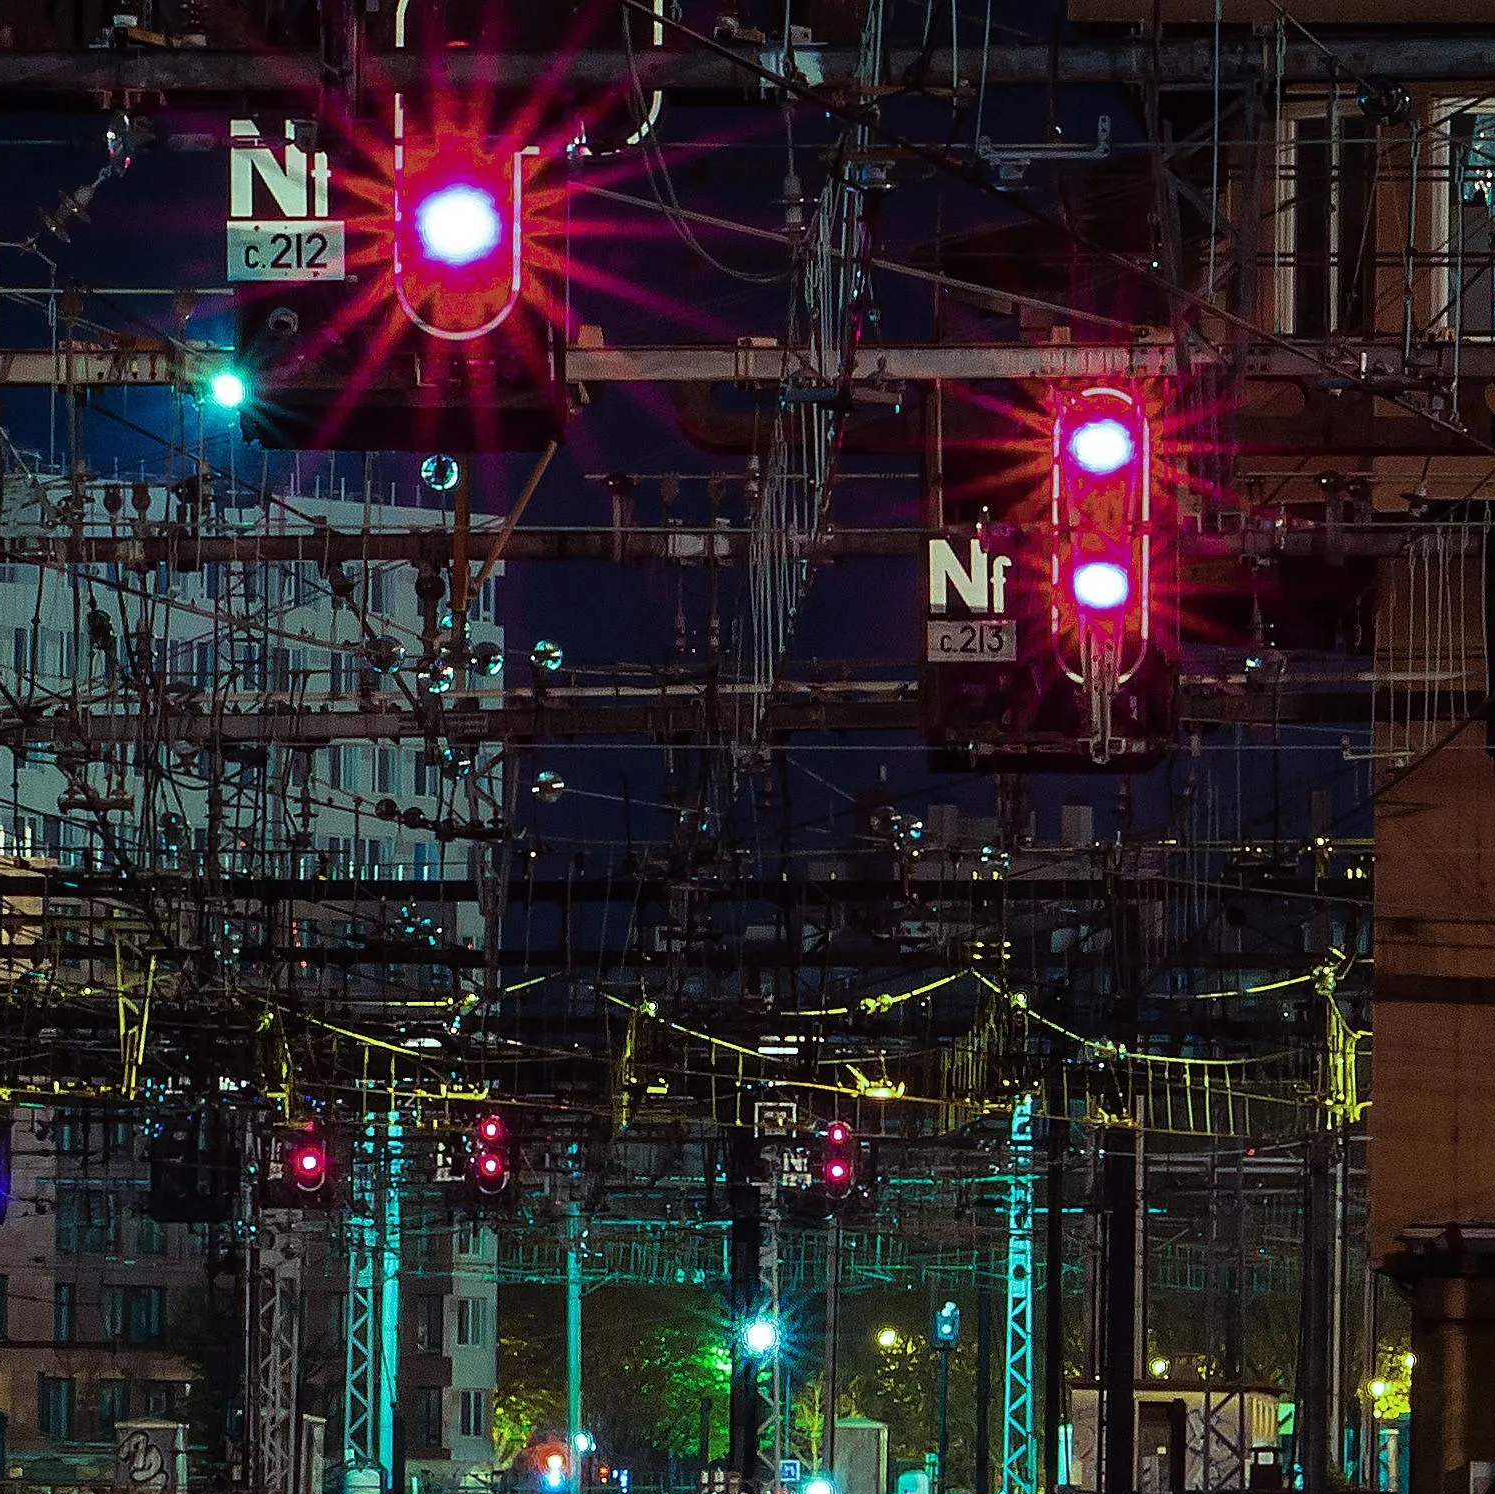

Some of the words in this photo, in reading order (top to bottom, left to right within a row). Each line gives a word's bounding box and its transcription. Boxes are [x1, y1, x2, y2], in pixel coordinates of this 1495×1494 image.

[244, 233, 327, 269] c.212
[928, 538, 1013, 613] Nf
[940, 625, 1004, 653] c.213
